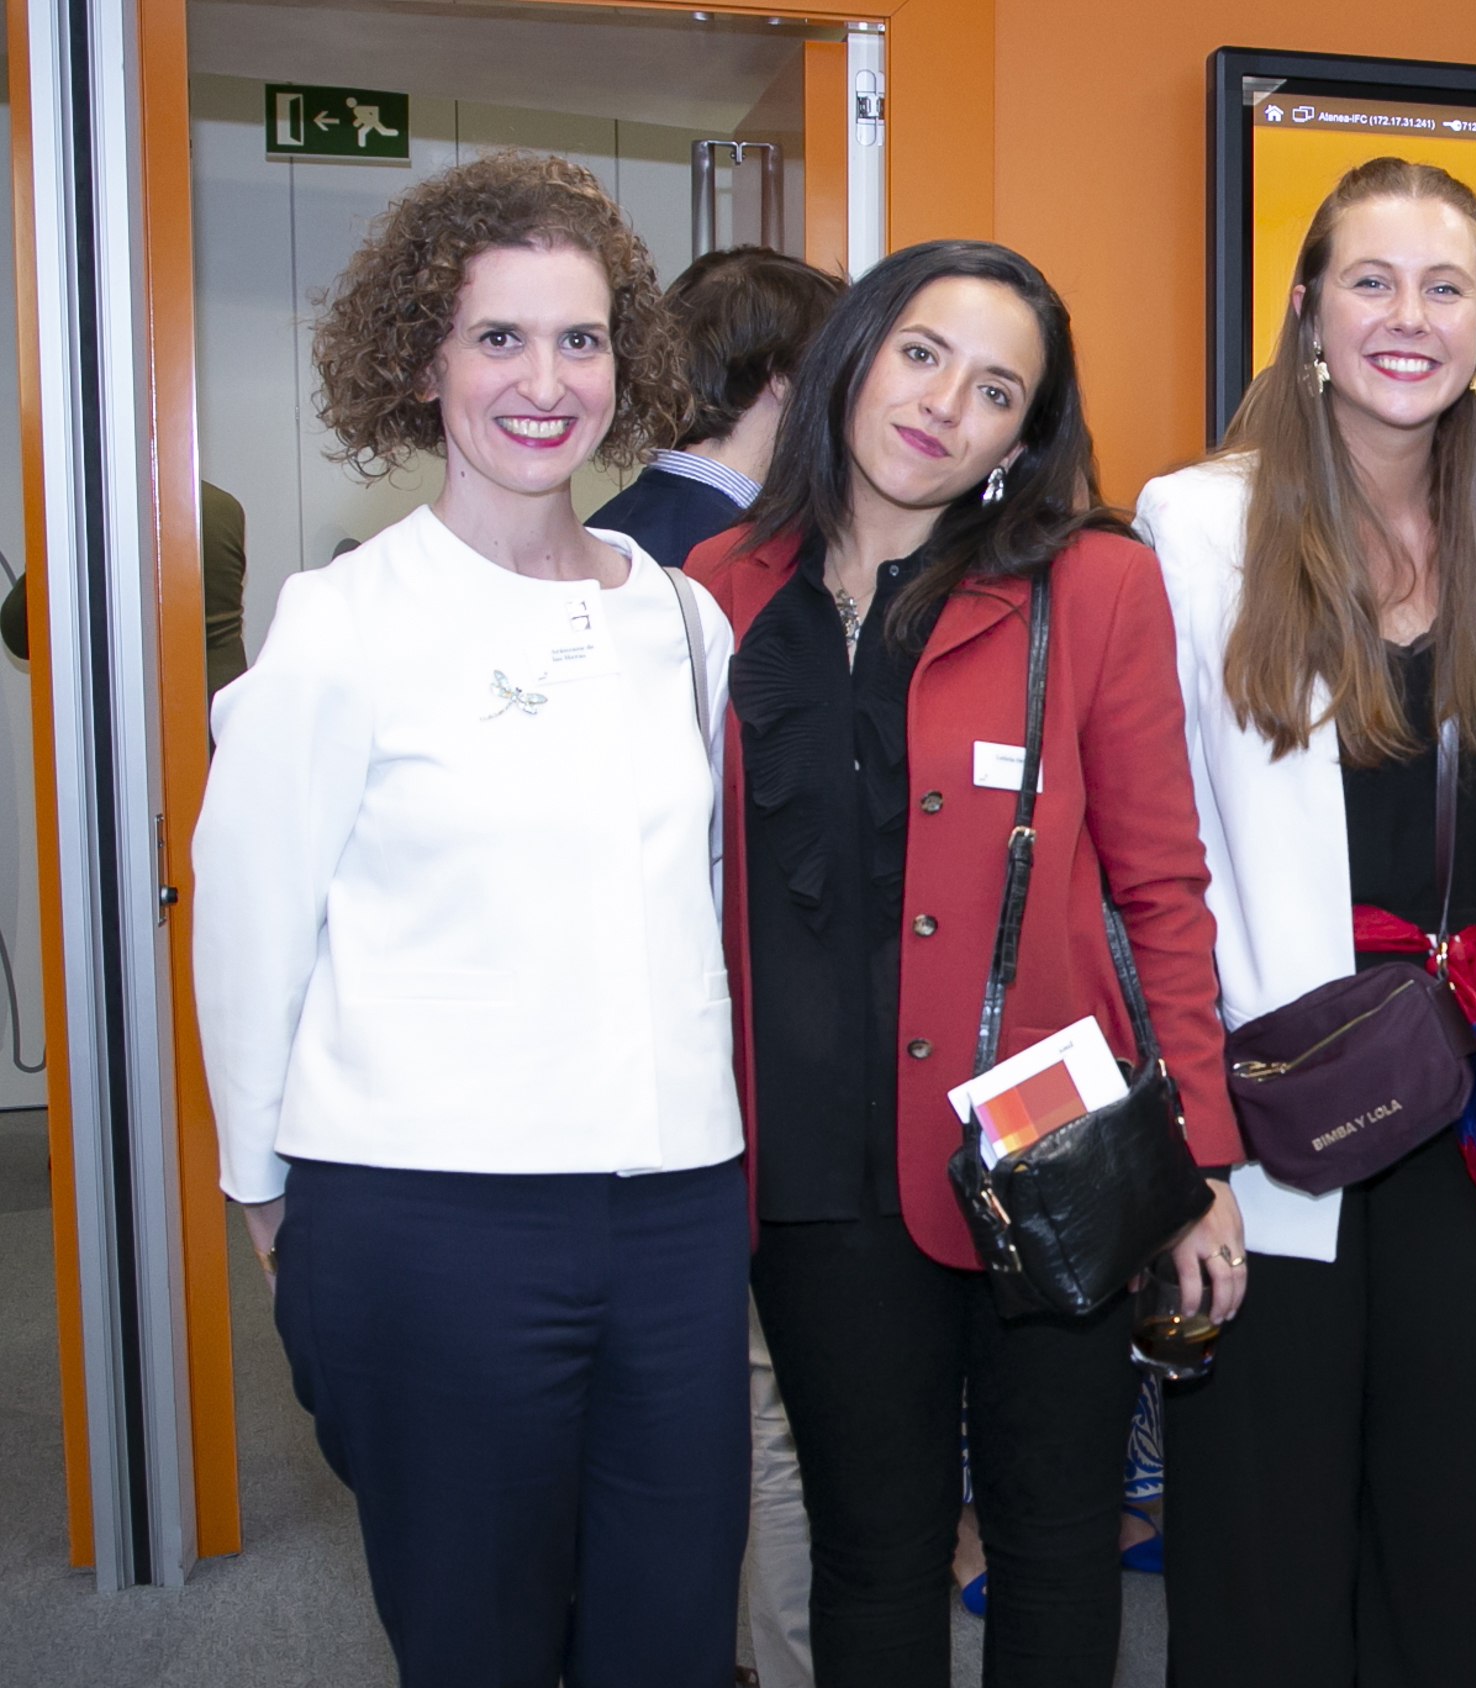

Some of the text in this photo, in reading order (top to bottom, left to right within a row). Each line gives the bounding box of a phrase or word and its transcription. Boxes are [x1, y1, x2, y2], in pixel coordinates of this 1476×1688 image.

[1318, 111, 1436, 131] Atenea-IFC (172.17.31.241)
[1311, 1099, 1403, 1152] BIMBA Y LOLA
